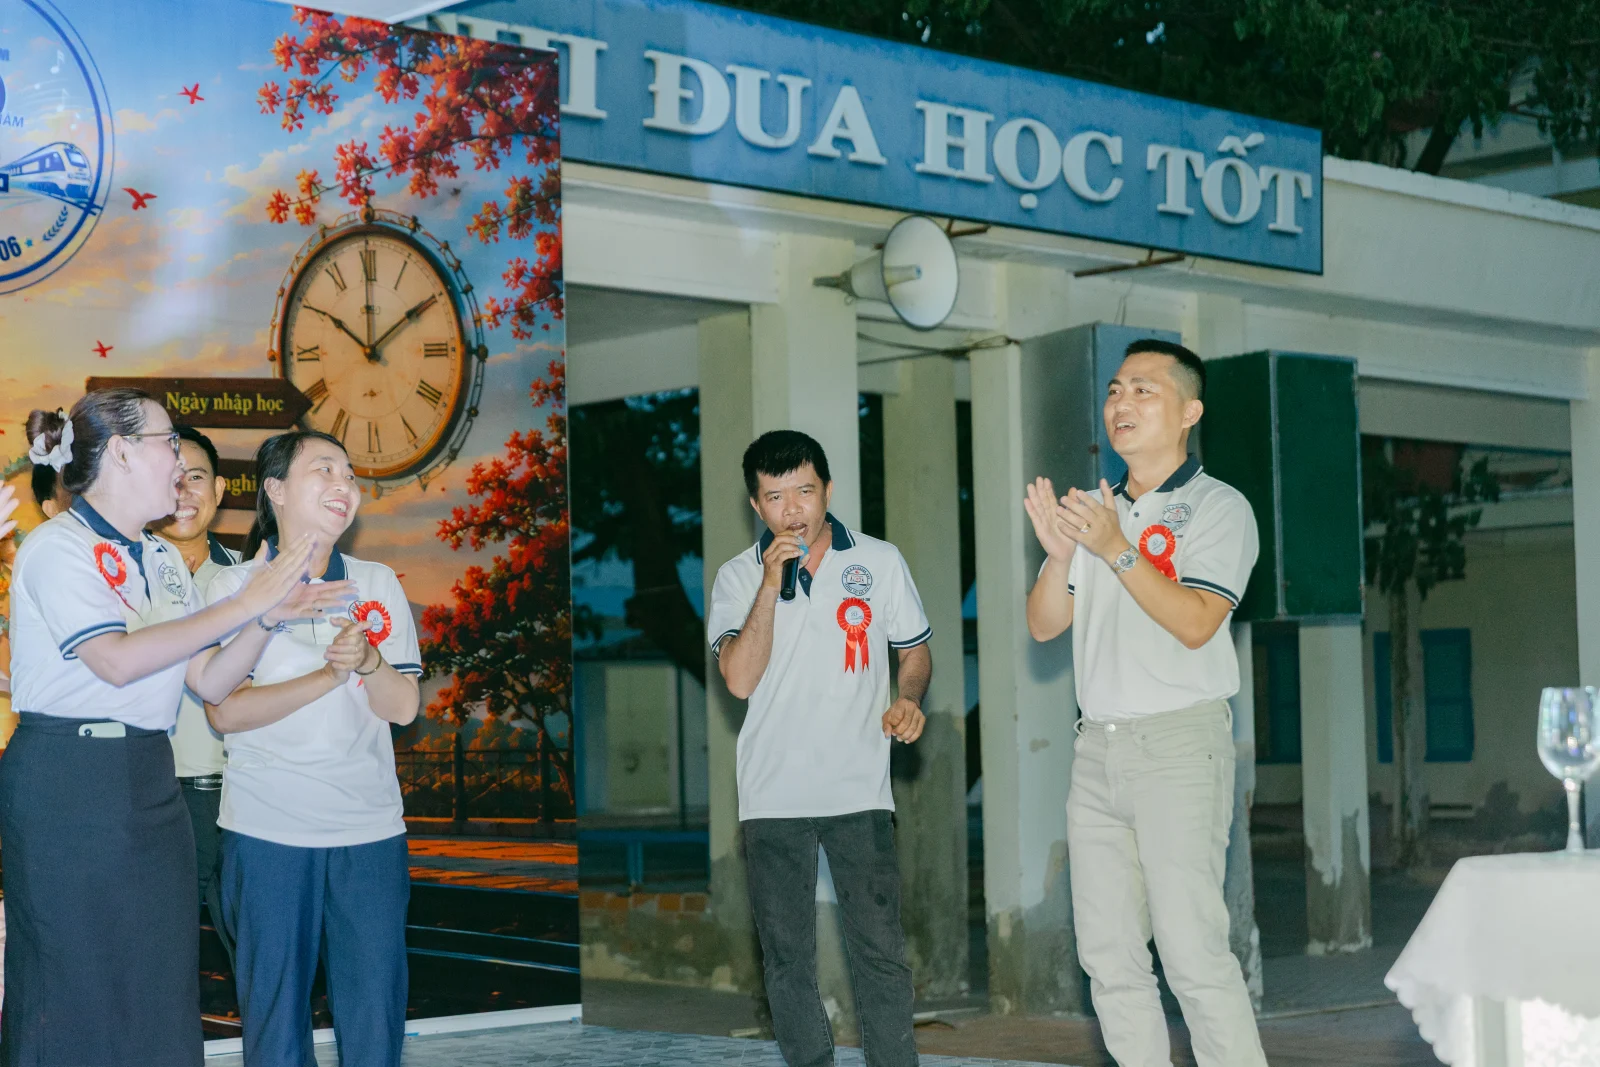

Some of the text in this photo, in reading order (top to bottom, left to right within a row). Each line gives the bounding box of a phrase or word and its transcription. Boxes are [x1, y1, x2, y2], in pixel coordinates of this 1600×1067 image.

[643, 50, 887, 166] ĐUA
[915, 100, 1124, 209] HỌC
[1146, 132, 1313, 234] TỐT
[166, 391, 284, 416] Ngày nhập học
